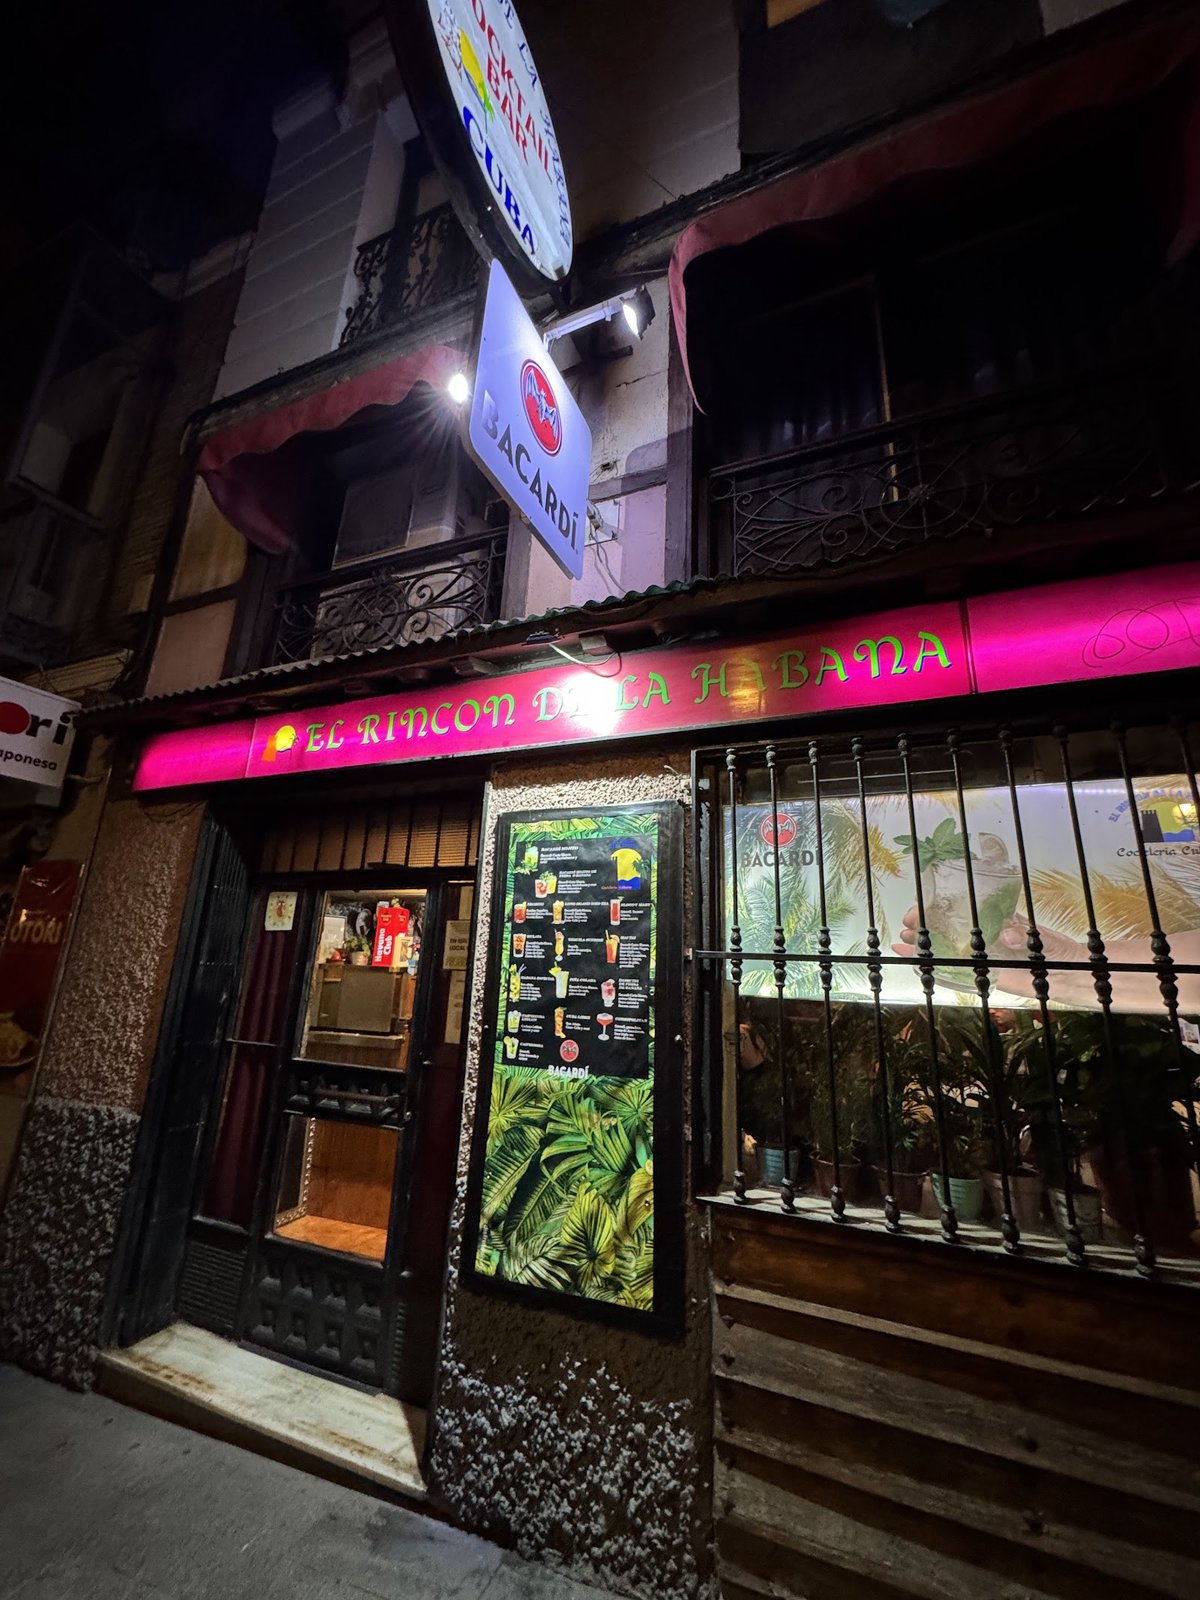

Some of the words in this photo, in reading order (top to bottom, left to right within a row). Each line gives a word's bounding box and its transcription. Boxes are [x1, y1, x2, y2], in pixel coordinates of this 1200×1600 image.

[517, 42, 537, 91] LA
[487, 52, 528, 166] BAR
[462, 106, 535, 255] CUBA
[481, 390, 579, 551] BACARDÍ
[305, 720, 345, 753] EL
[357, 693, 516, 746] RINCON
[614, 672, 671, 712] LA
[690, 631, 952, 704] HABANA
[374, 928, 386, 962] Havana
[383, 935, 393, 956] Club
[548, 1064, 590, 1080] BACARDÍ
